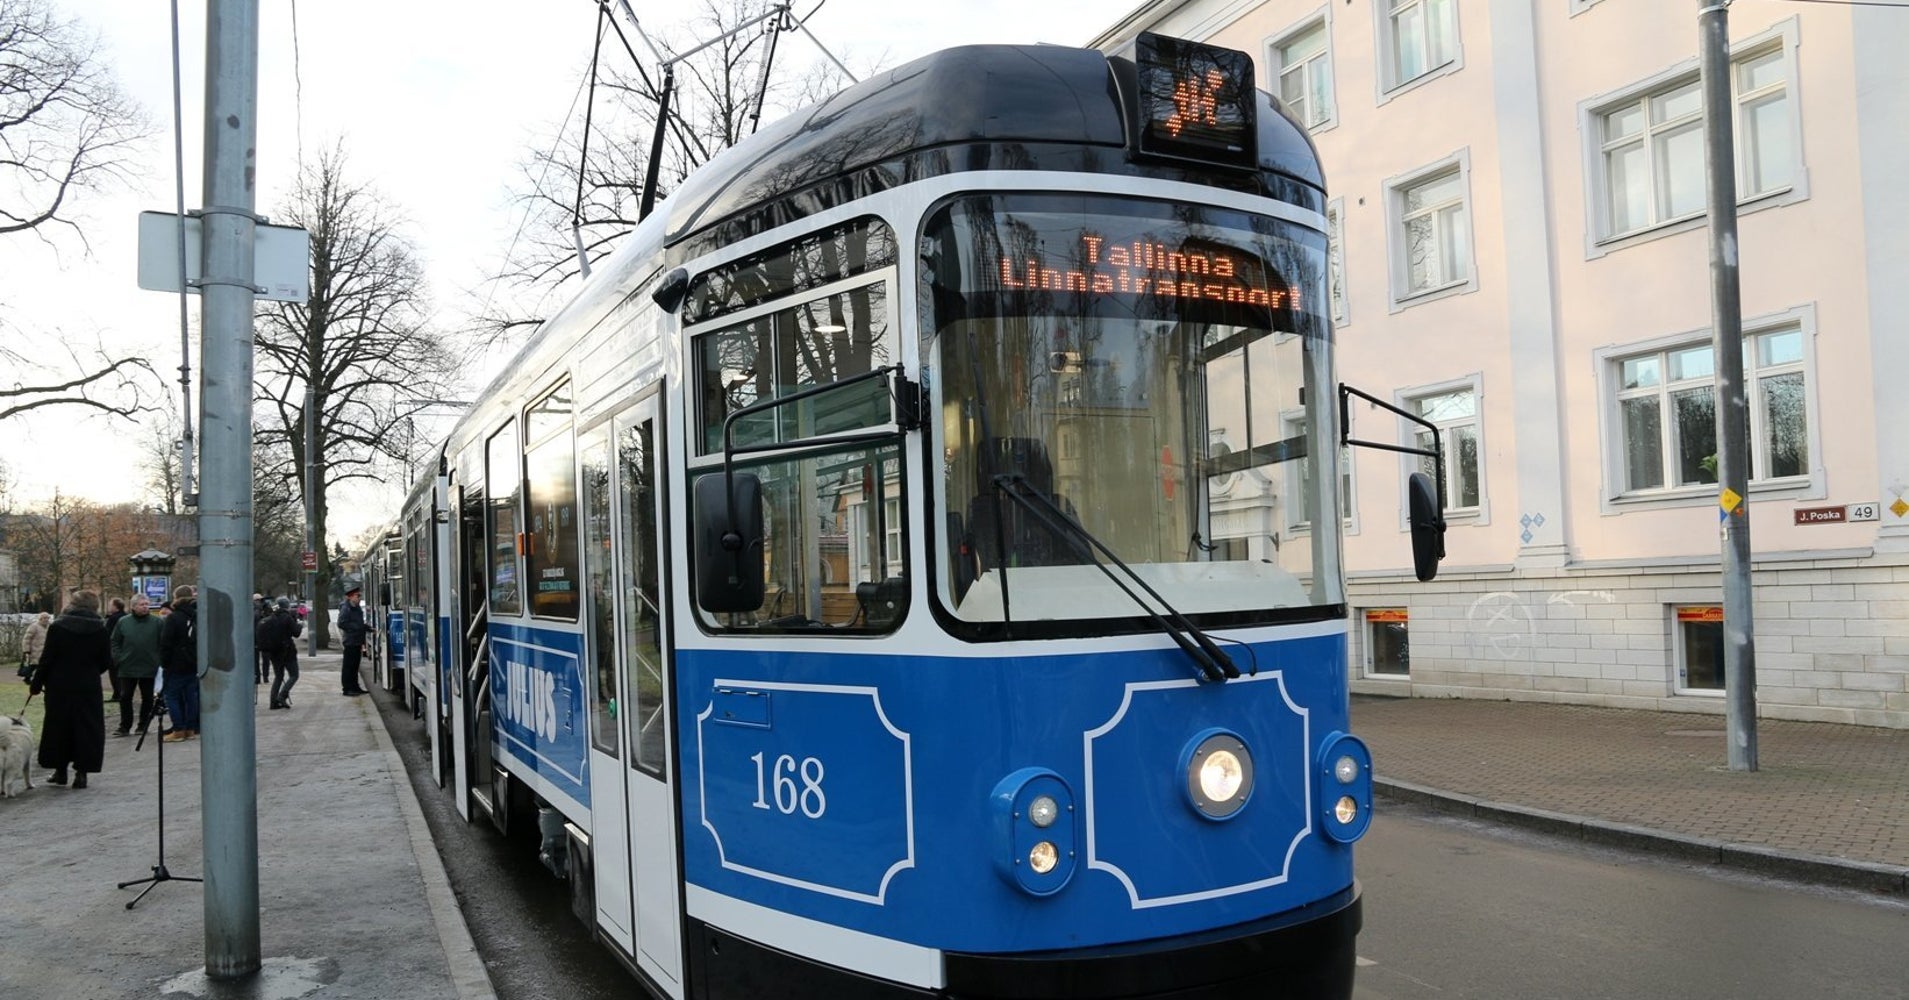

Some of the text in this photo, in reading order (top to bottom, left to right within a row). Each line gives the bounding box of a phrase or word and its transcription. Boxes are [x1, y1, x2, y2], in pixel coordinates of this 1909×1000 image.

[1082, 235, 1234, 277] Tallinna
[1800, 510, 1840, 521] J. Poska
[1854, 506, 1873, 518] 49
[506, 660, 557, 744] JULIUS
[751, 751, 826, 819] 168
